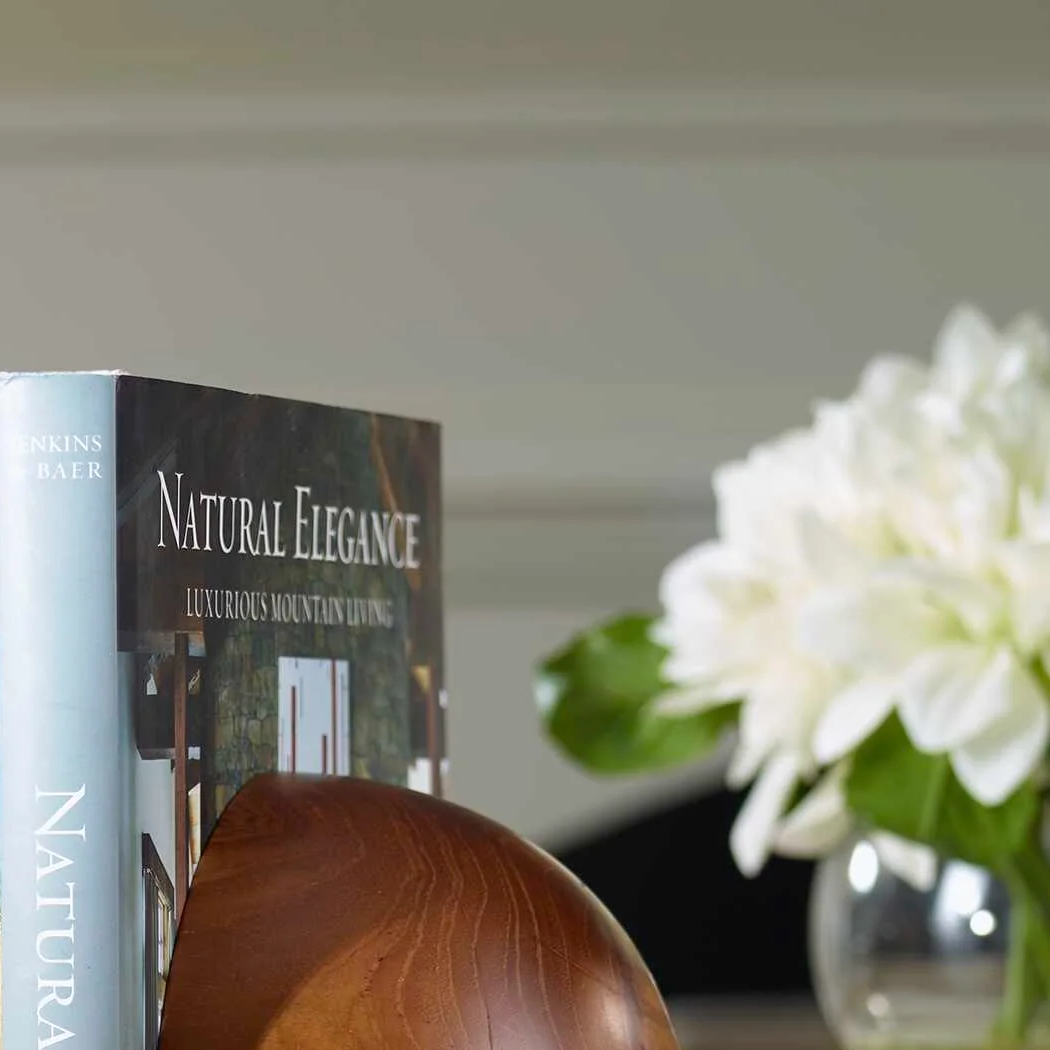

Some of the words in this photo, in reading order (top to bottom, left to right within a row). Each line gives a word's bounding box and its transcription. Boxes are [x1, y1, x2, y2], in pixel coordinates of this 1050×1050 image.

[16, 434, 102, 453] ENKINS
[37, 461, 103, 480] BAER
[156, 469, 286, 558] NATURAL
[294, 485, 421, 569] ELEGANCE
[186, 587, 268, 622] LUXURIOUS
[270, 593, 344, 626] MOUNTAIN
[346, 597, 394, 630] LIVING
